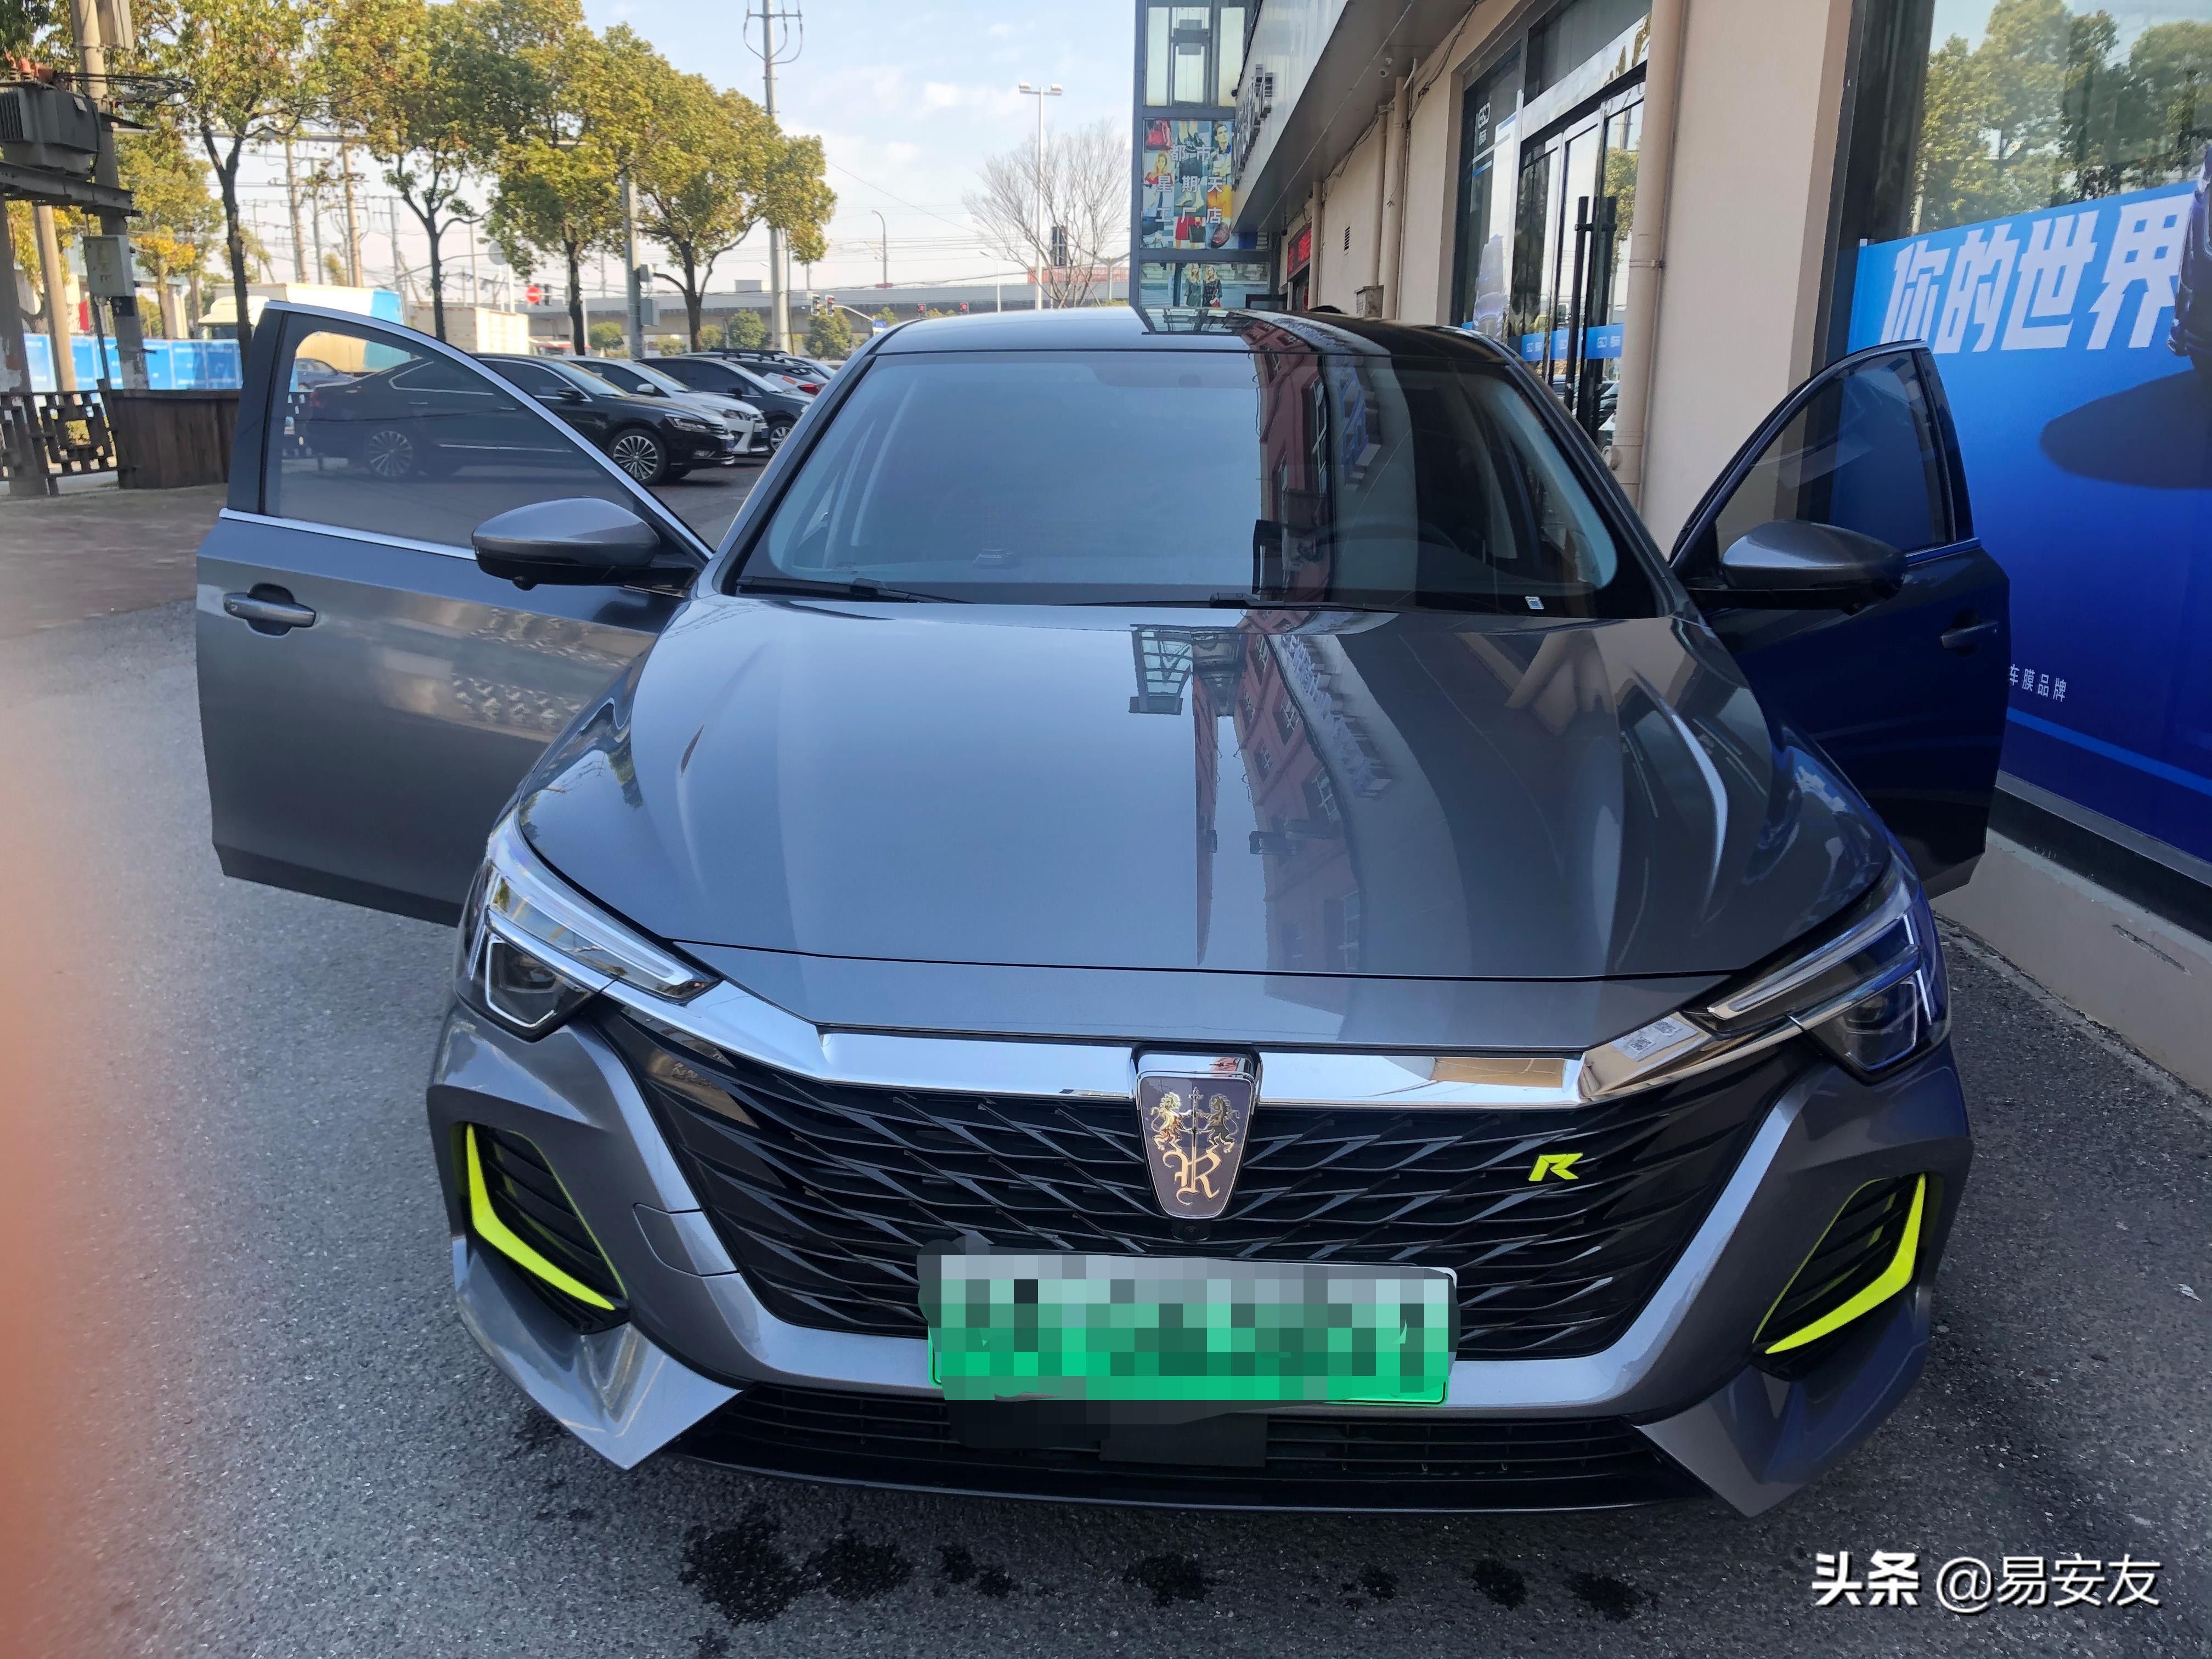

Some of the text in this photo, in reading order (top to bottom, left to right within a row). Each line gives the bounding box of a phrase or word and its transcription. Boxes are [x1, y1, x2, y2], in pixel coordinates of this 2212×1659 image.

[1170, 145, 1212, 162] 都市
[1156, 176, 1223, 193] 星期天
[1155, 207, 1222, 224] 工厂店
[1880, 193, 2194, 354] 你的世界
[2010, 663, 2067, 702] 车膜品牌
[1528, 1153, 1583, 1182] R
